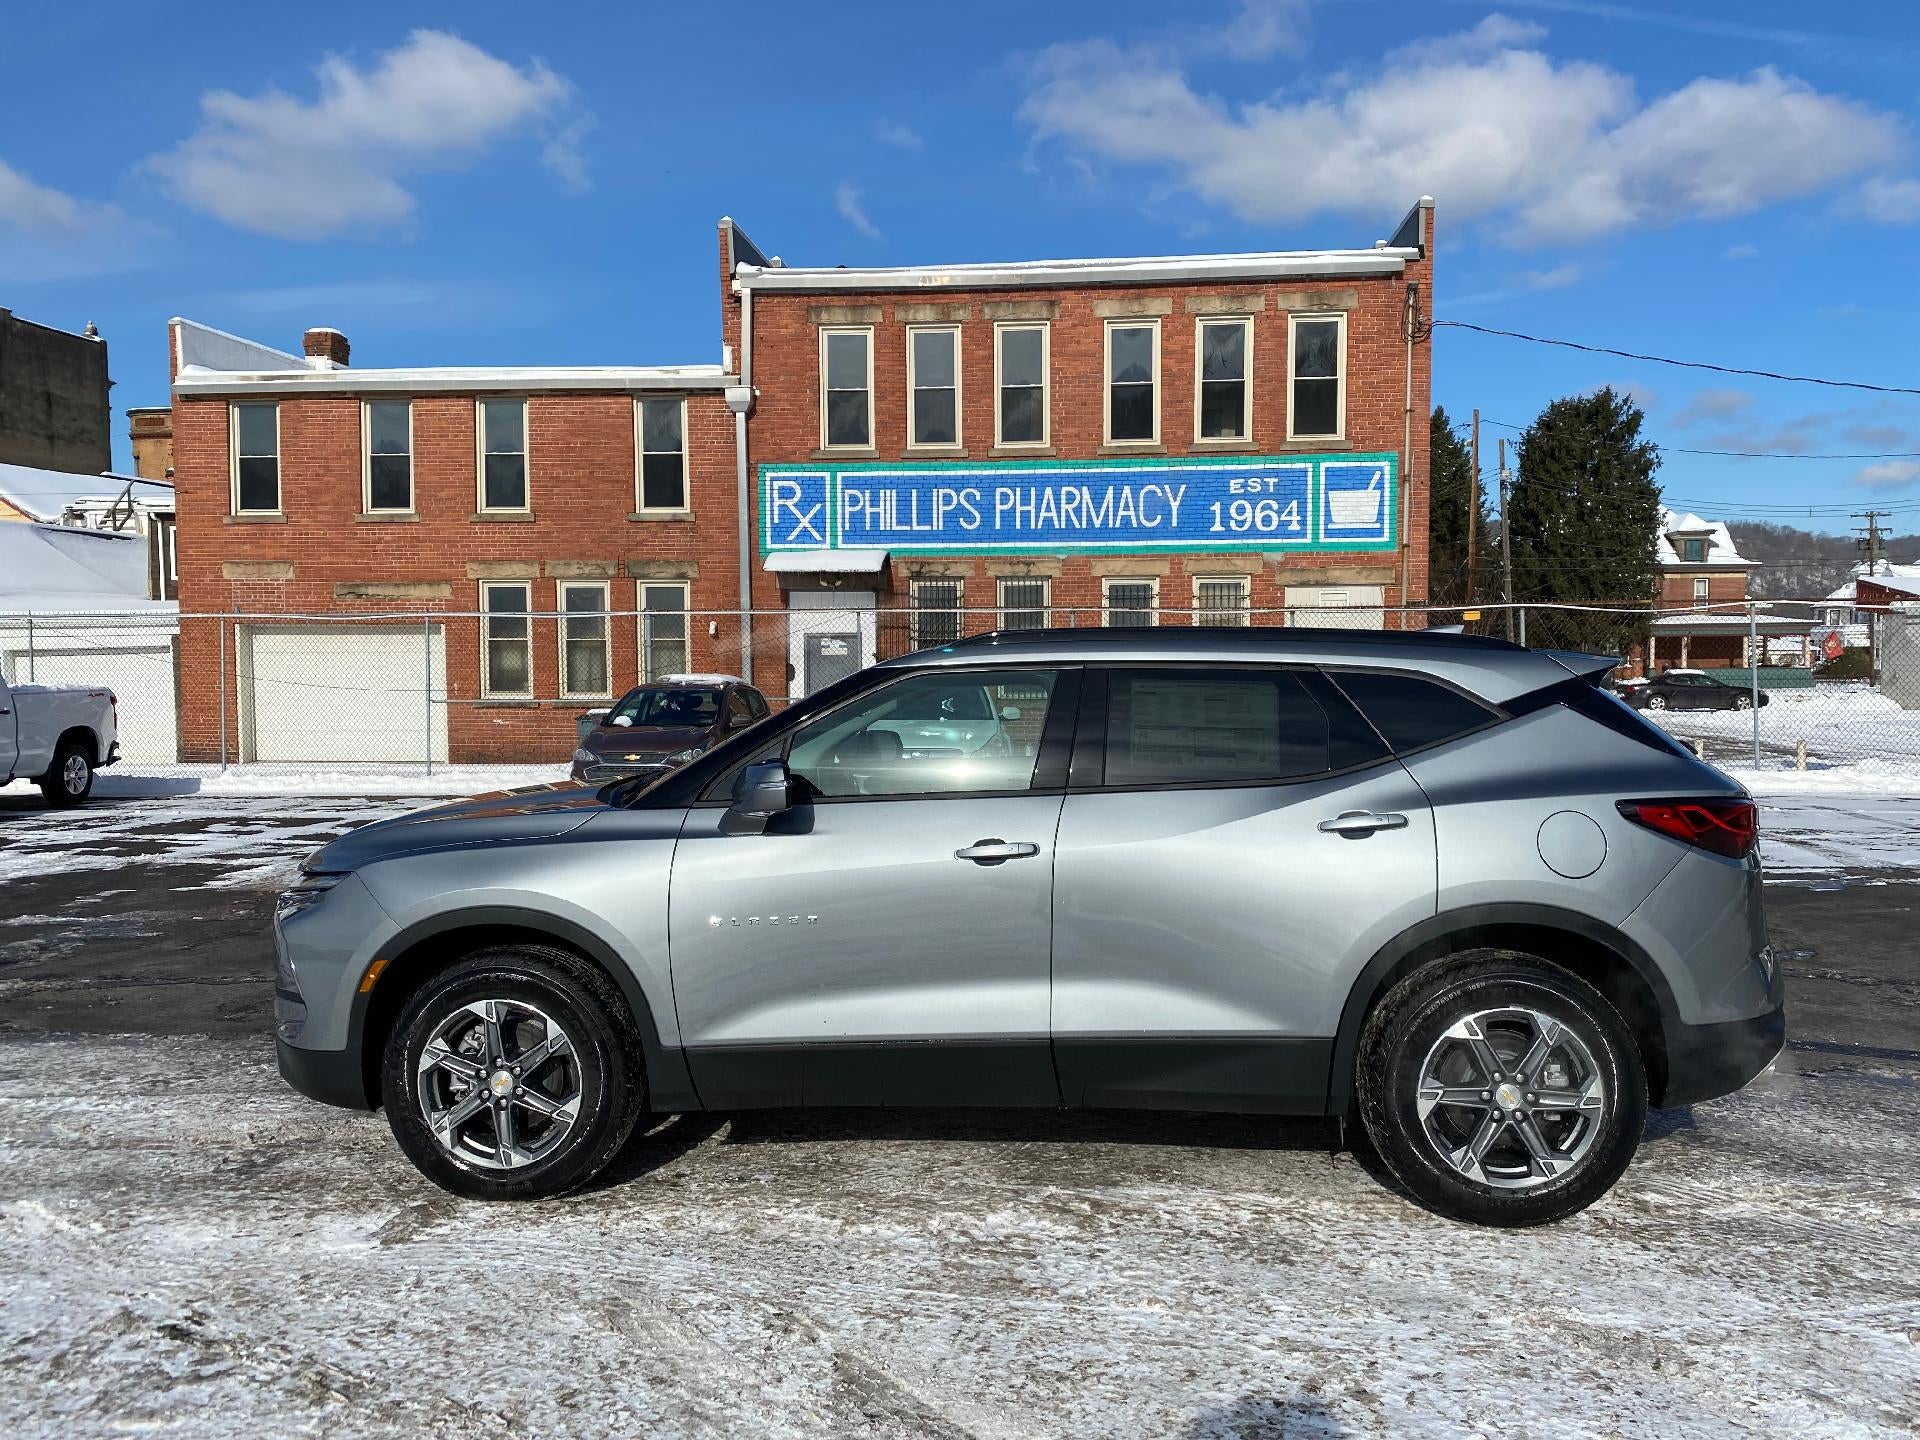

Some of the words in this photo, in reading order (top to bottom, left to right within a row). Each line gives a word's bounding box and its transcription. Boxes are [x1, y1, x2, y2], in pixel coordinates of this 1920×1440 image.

[1229, 477, 1279, 494] EST
[843, 488, 981, 531] PHILLIPS
[995, 484, 1187, 530] PHARMACY
[1209, 500, 1301, 532] 1964
